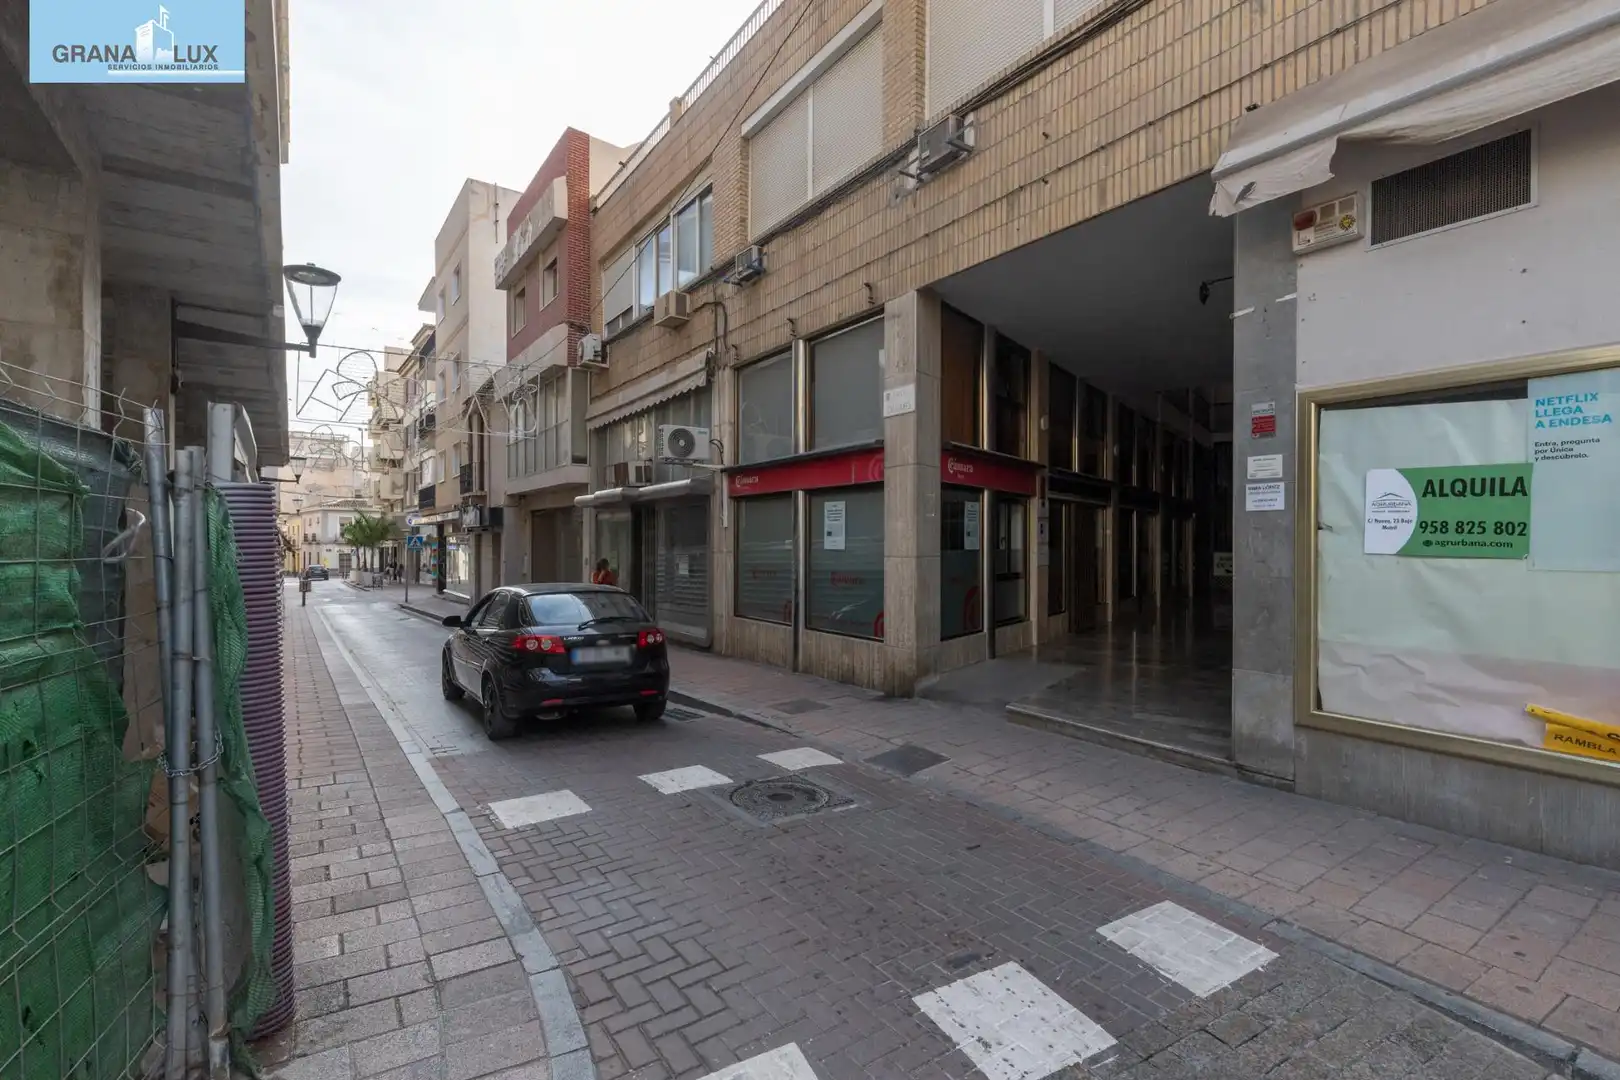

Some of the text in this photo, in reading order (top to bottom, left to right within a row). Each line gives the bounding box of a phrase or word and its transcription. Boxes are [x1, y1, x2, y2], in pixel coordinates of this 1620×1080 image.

[1535, 392, 1598, 407] NETFLIX
[1535, 405, 1584, 418] LLEGA
[1535, 413, 1612, 429] A ENDESA
[1560, 437, 1601, 446] pregunta
[1421, 476, 1528, 498] ALQUILA
[1419, 520, 1527, 537] 958 825 802
[1434, 539, 1513, 548] agrurbana.com
[1554, 733, 1616, 754] RAMBLA
